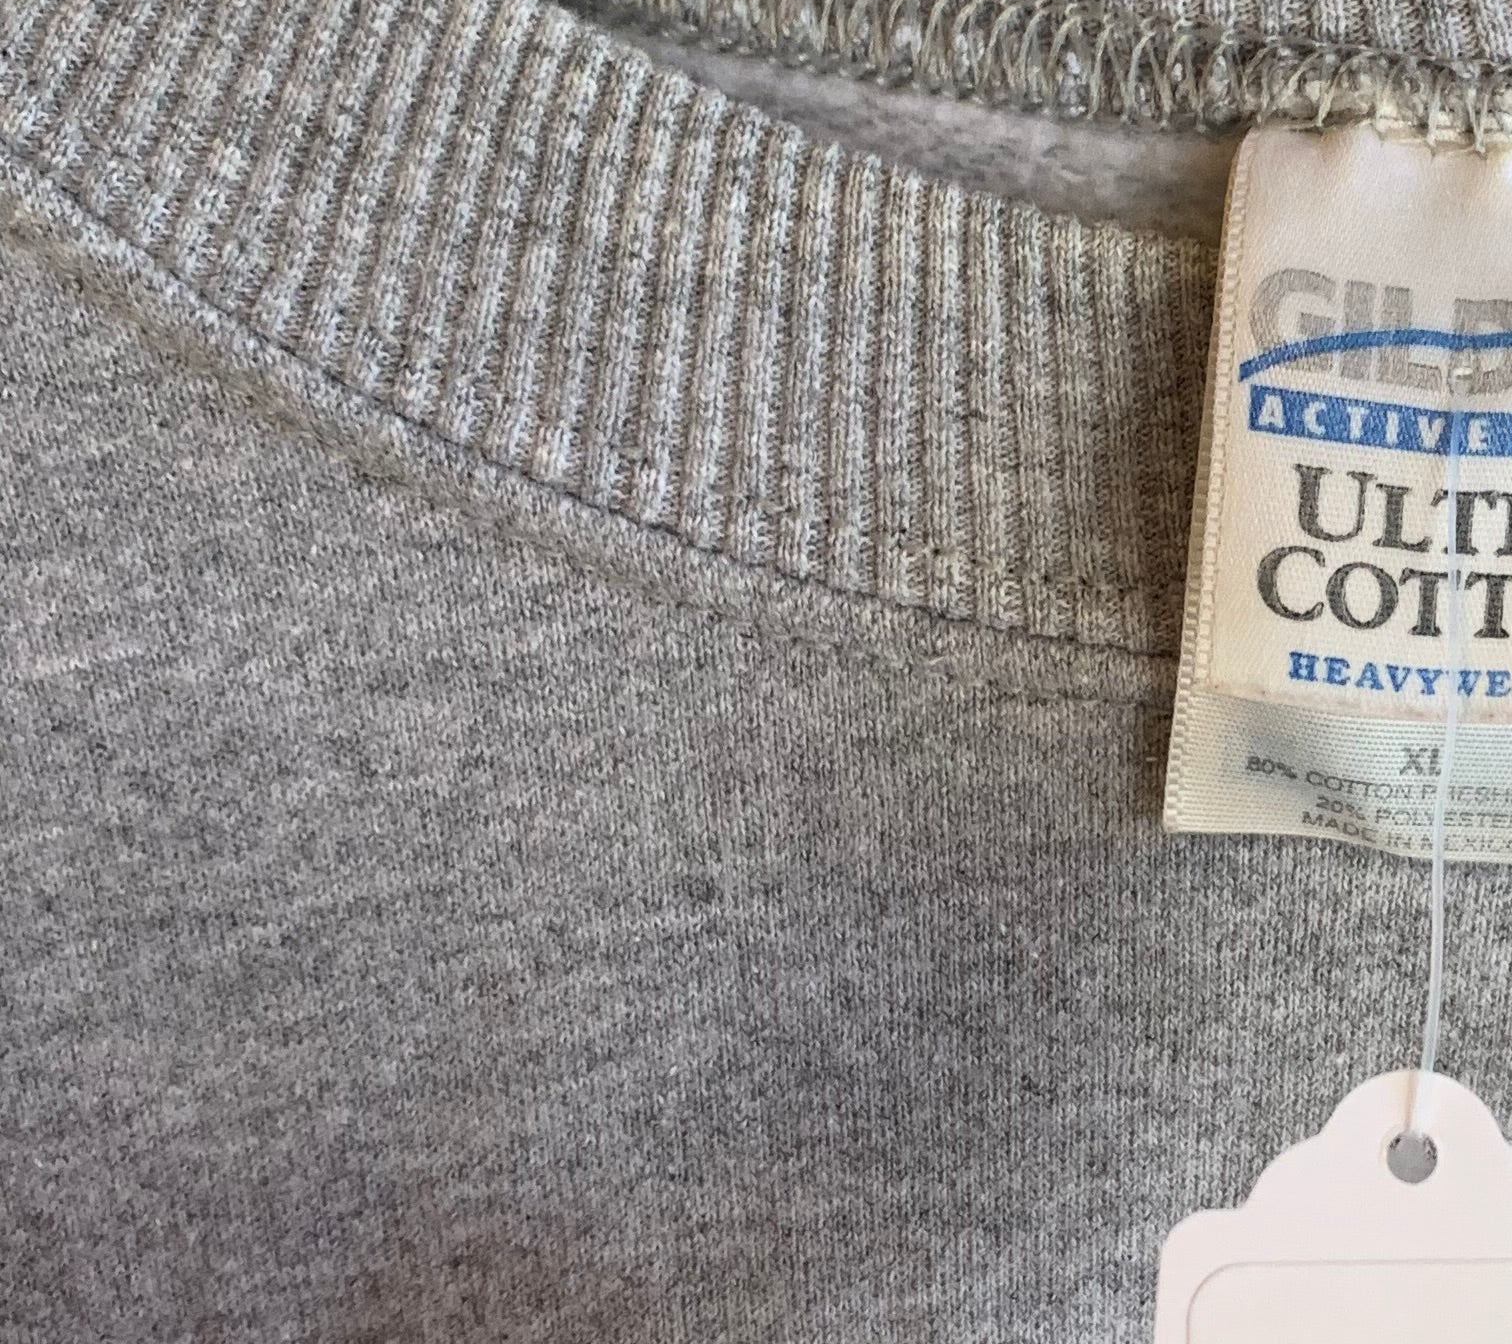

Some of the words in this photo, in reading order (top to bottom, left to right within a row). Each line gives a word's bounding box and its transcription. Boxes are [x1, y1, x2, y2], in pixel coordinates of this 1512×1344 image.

[1245, 755, 1298, 780] 80%
[1305, 770, 1412, 800] COTTON
[1315, 795, 1367, 821] 20%
[1302, 810, 1378, 844] MADE
